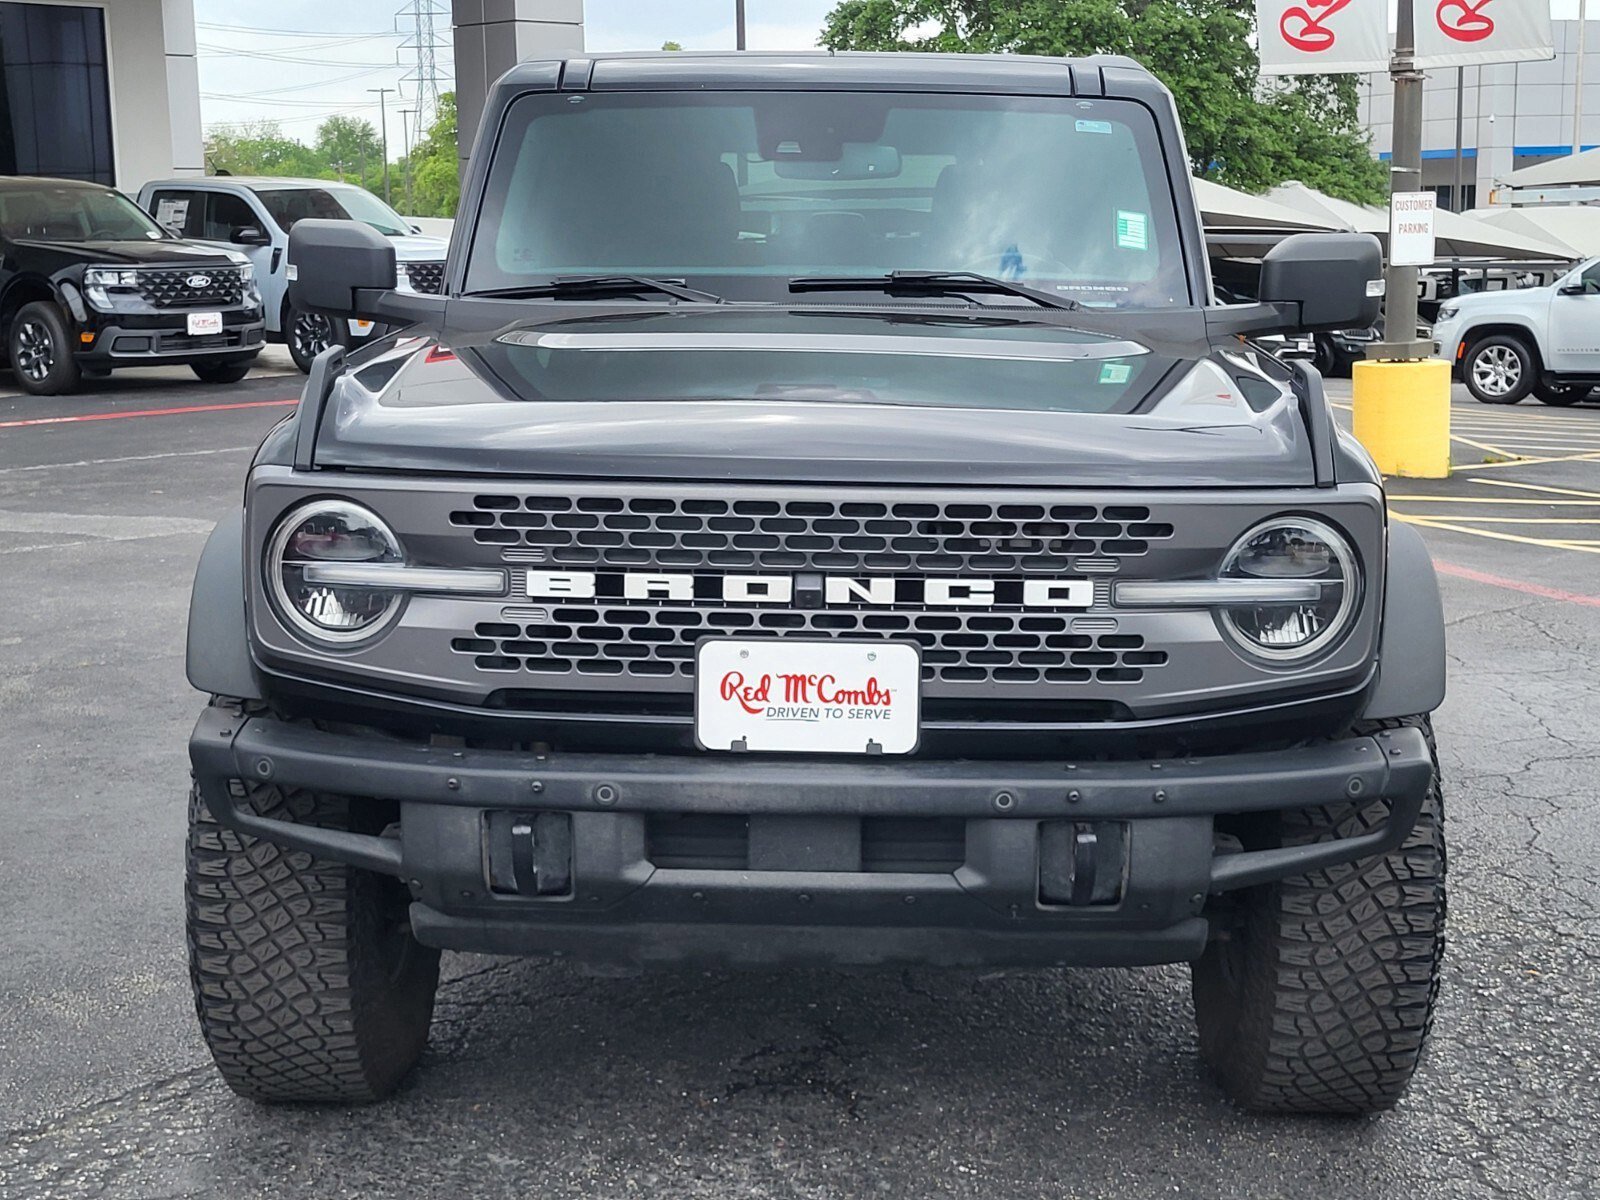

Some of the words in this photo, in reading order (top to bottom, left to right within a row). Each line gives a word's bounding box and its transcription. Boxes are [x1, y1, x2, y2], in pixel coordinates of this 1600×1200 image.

[1395, 200, 1433, 211] CUSTOMER
[1398, 222, 1429, 234] PARKING
[525, 570, 1094, 607] BRONCO
[720, 671, 771, 714] Red
[776, 674, 891, 706] McCombs
[766, 706, 820, 719] DRIVEN
[825, 708, 843, 718] TO
[848, 708, 891, 720] SERVE
